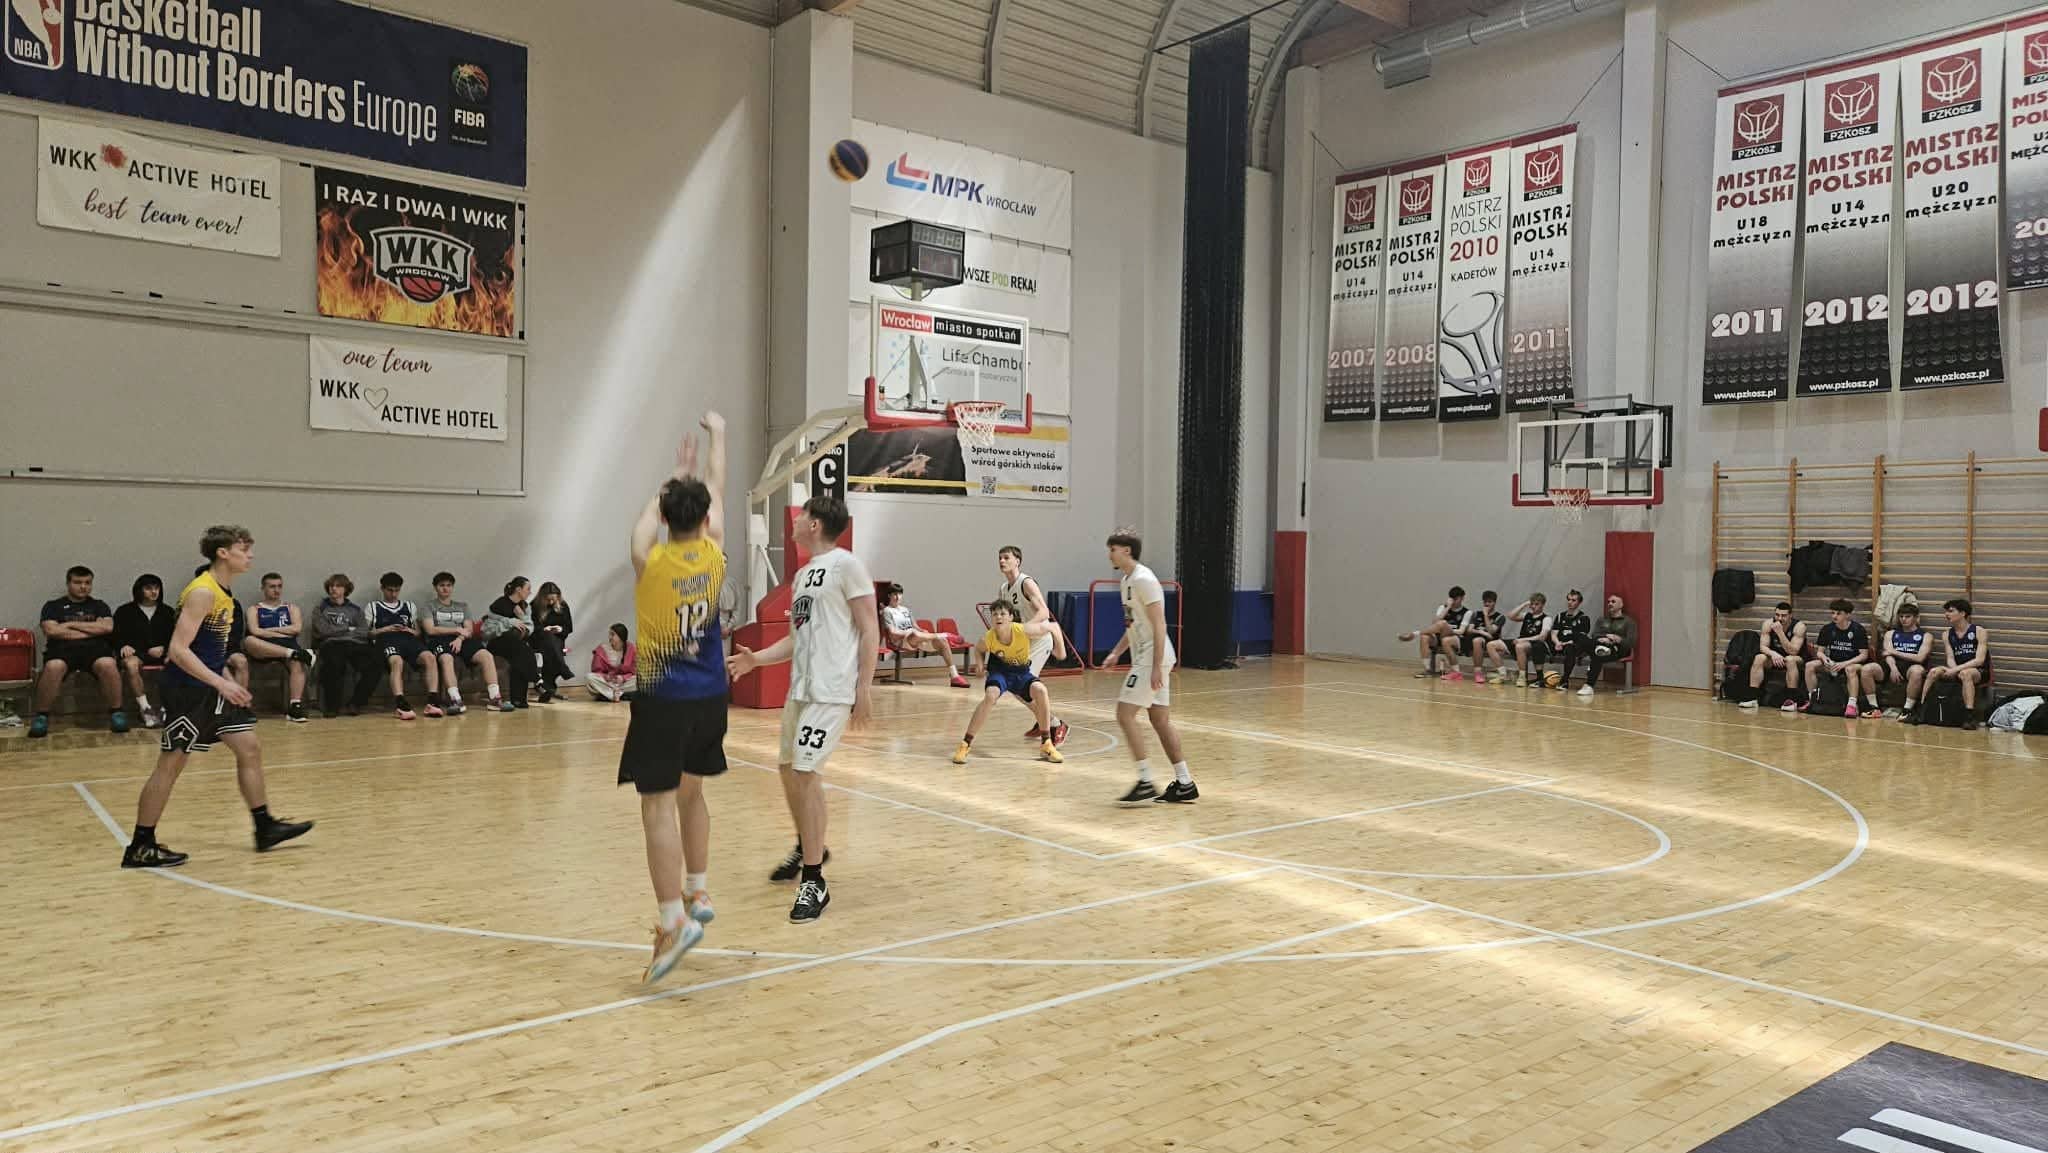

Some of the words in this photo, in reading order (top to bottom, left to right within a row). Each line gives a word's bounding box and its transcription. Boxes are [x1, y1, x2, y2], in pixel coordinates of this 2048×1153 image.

[14, 37, 42, 60] NBA
[74, 20, 210, 98] Without
[217, 51, 346, 124] Borders
[353, 79, 437, 147] Europe
[454, 108, 485, 128] FIBA
[1905, 122, 1999, 158] MISTRZ
[50, 144, 97, 171] WKK
[128, 159, 199, 188] ACTIVE
[211, 173, 272, 200] HOTEL
[1807, 144, 1894, 176] MISTRZ
[1906, 145, 1998, 179] POLSKI
[1716, 163, 1796, 192] MISTRZ
[1808, 166, 1893, 196] POLSKI
[931, 172, 985, 204] MPK
[985, 194, 1037, 217] WROCŁAW
[1716, 184, 1794, 212] POLSKI
[1905, 194, 1998, 219] mężczyzn
[84, 187, 129, 219] best
[139, 200, 190, 226] team
[195, 215, 243, 236] ever!
[323, 183, 329, 199] I
[336, 186, 378, 208] RAZ
[384, 193, 389, 210] I
[396, 196, 445, 220] DWA
[451, 205, 456, 222] I
[462, 207, 508, 231] WKK
[1451, 196, 1503, 220] MISTRZ
[1512, 203, 1571, 229] MISTRZ
[1450, 214, 1502, 238] POLSKI
[1806, 212, 1890, 234] mężczyzn
[1335, 238, 1382, 258] MISTRZ
[1389, 230, 1440, 251] MISTRZ
[1450, 234, 1499, 263] 2010
[1713, 229, 1792, 248] mężczyzn
[385, 236, 459, 275] WKK
[991, 271, 1009, 288] POD
[1450, 265, 1498, 283] KADETÓW
[1512, 260, 1570, 277] mężczyz
[1906, 280, 1999, 316] 2012
[1711, 307, 1783, 338] 2011
[1804, 294, 1889, 327] 2012
[935, 318, 973, 334] miasto
[976, 327, 1017, 341] spotkań
[343, 350, 378, 369] one
[381, 347, 432, 373] team
[942, 347, 969, 364] Life
[972, 351, 1025, 370] Chamb
[1328, 347, 1375, 369] 2007
[1385, 343, 1435, 367] 2008
[1809, 378, 1879, 392] www.pzkosz.pl
[1914, 369, 1990, 384] www.pzkosz.pl
[320, 378, 360, 400] WKK
[1714, 388, 1777, 401] www.pzkosz.pl
[381, 404, 441, 426] ACTIVE
[447, 409, 499, 430] HOTEL
[971, 445, 1011, 456] Sportowe
[1012, 447, 1056, 460] aktywności
[997, 458, 1032, 470] górskich
[818, 457, 837, 485] C
[805, 568, 826, 588] 33
[1126, 674, 1138, 688] 0
[798, 725, 827, 749] 33
